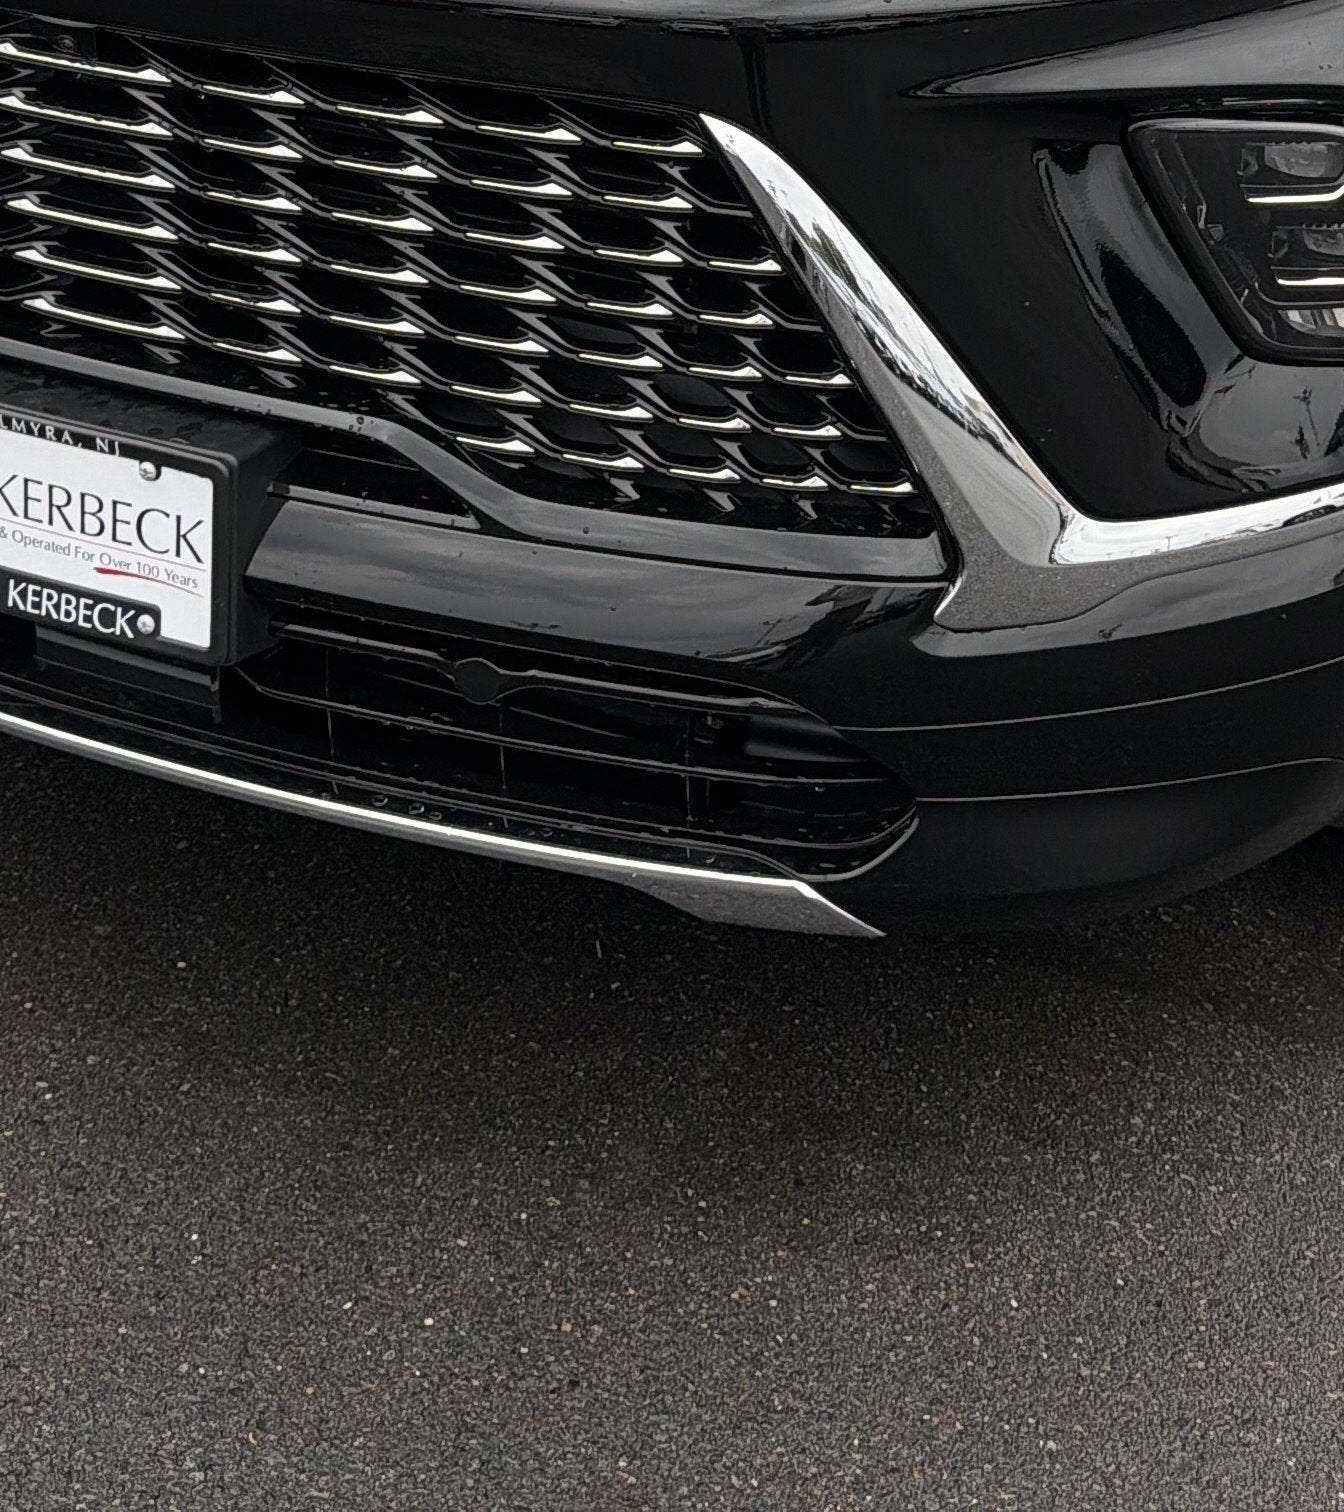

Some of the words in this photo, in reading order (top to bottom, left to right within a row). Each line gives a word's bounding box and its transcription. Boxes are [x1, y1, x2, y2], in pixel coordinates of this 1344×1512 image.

[96, 437, 120, 457] NJ
[0, 525, 8, 538] &
[12, 529, 71, 556] Operated
[75, 546, 95, 562] For
[99, 552, 132, 570] Over
[136, 561, 160, 578] 100
[164, 567, 198, 588] Years
[7, 578, 136, 639] KERBECK
